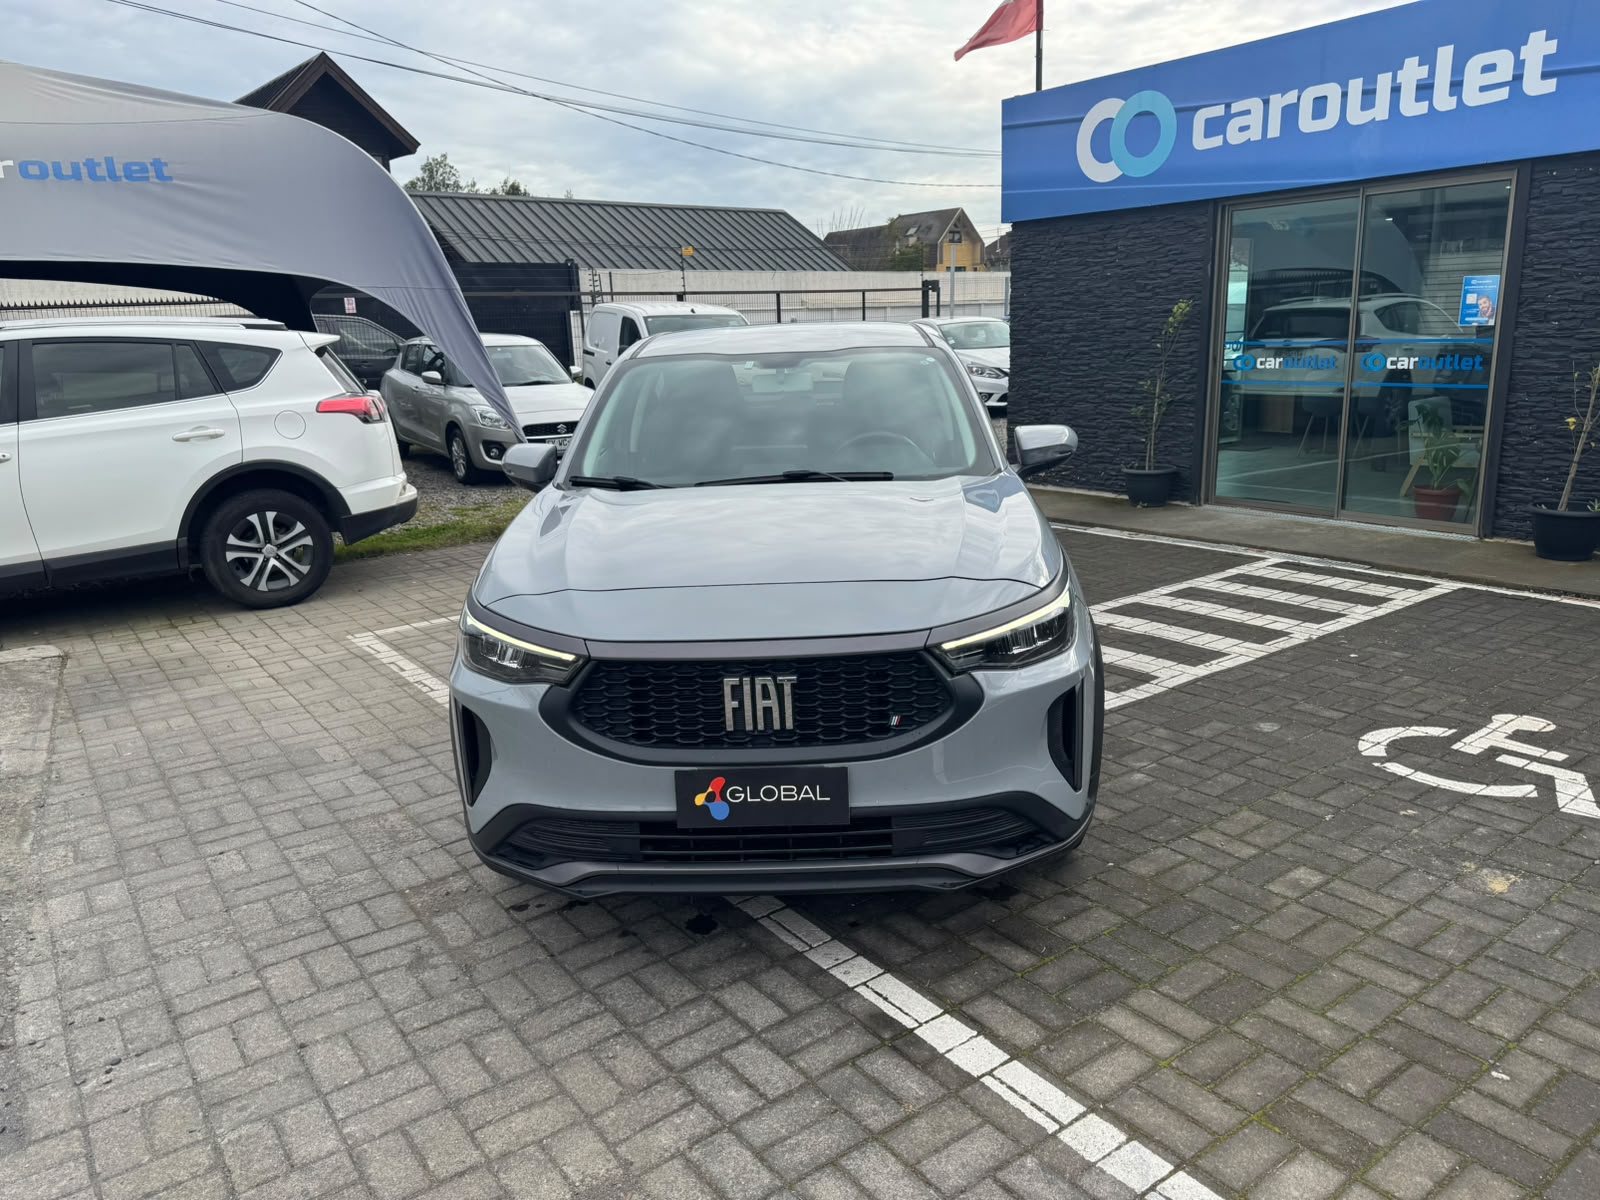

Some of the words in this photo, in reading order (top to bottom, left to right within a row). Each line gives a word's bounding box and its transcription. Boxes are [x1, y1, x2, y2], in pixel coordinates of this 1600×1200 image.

[1192, 29, 1558, 151] caroutlet
[1256, 355, 1337, 370] caroutlet
[1386, 354, 1484, 371] caroutlet
[723, 676, 797, 731] FIAT
[726, 785, 831, 802] GLOBAL
